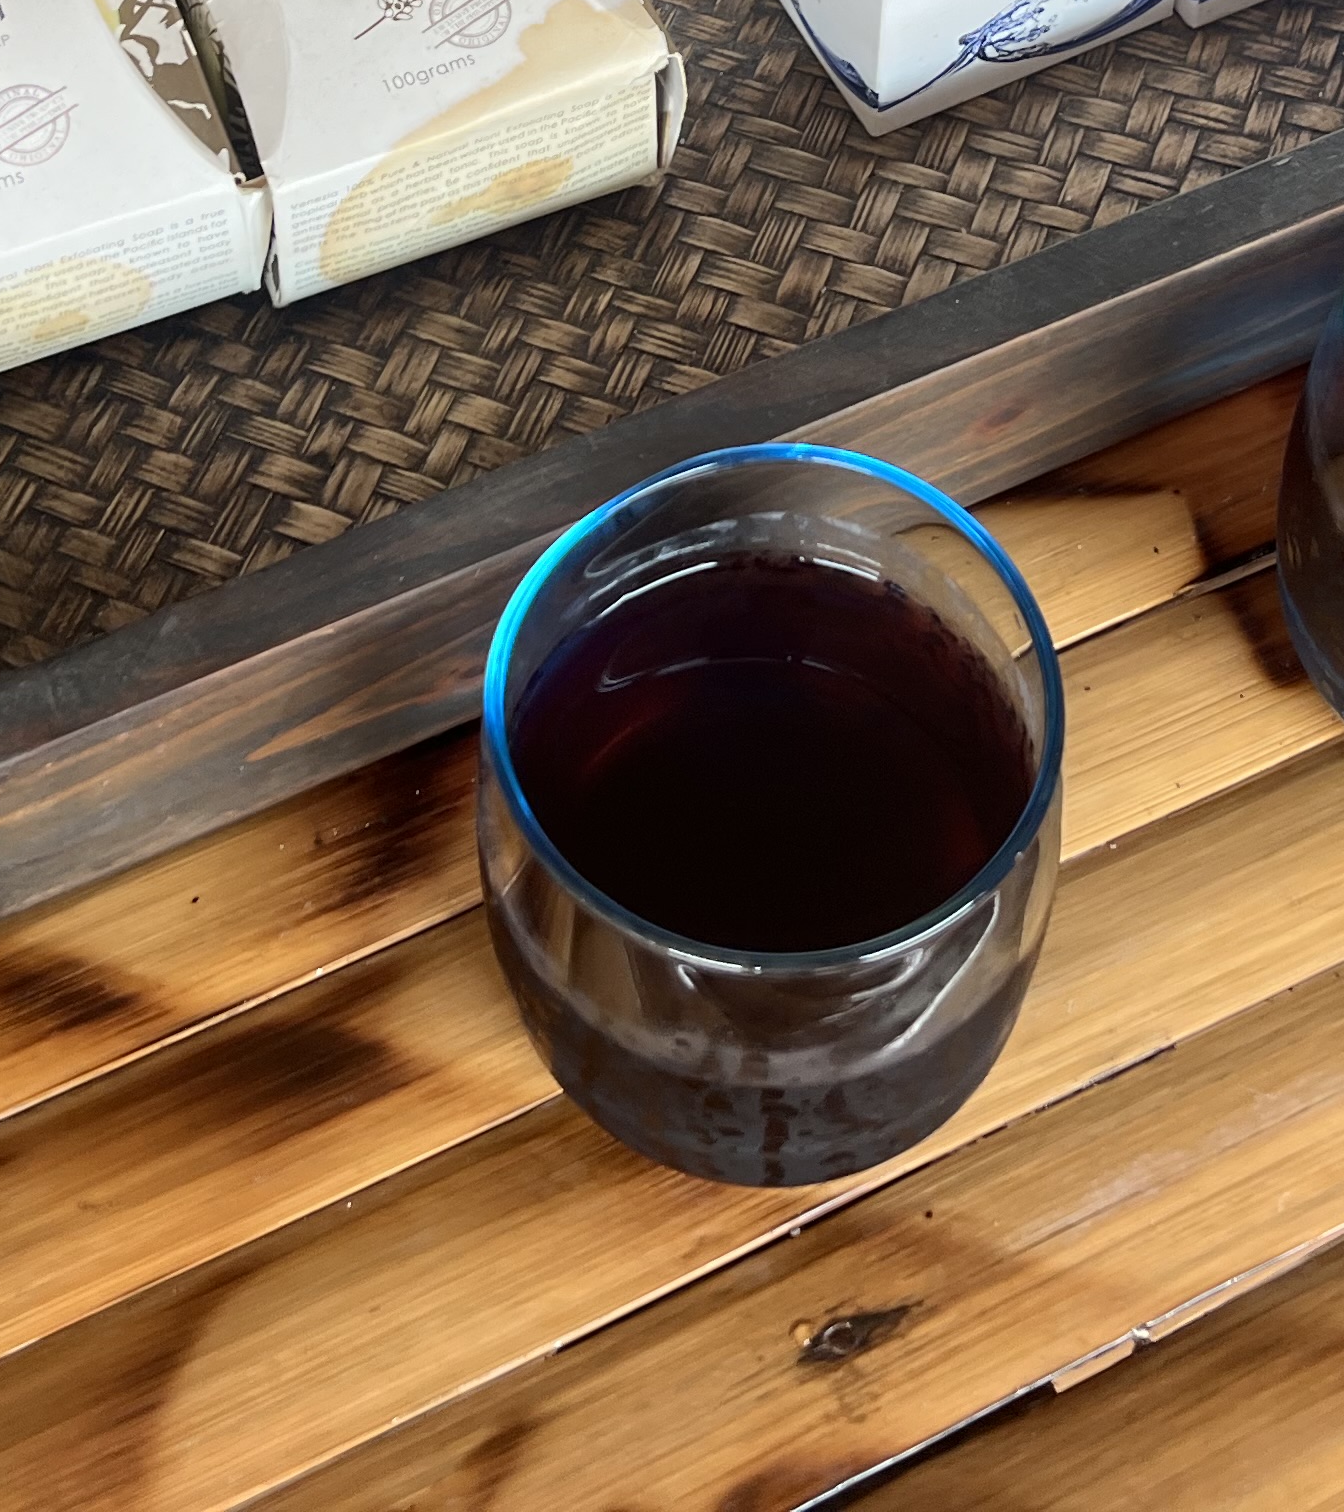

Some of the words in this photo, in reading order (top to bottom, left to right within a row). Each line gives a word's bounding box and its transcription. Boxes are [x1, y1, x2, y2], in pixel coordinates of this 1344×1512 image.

[382, 51, 476, 94] 100grams
[293, 190, 338, 208] Venezia
[383, 168, 405, 179] Pure
[428, 144, 468, 161] Natural
[476, 132, 499, 145] Noni
[507, 110, 564, 134] Exfoliating
[572, 98, 599, 112] Soap
[294, 200, 337, 218] tropical
[372, 179, 403, 193] which
[429, 157, 458, 171] been
[462, 143, 495, 159] widely
[500, 133, 524, 146] used
[528, 127, 536, 136] in
[542, 122, 557, 132] the
[563, 109, 597, 125] Pacific
[406, 173, 442, 190] herbal
[491, 148, 508, 159] This
[517, 137, 543, 151] soap
[566, 118, 600, 134] known
[468, 155, 519, 178] confident
[529, 145, 550, 158] that
[25, 262, 53, 274] Noni
[61, 239, 125, 263] Exfoliating
[133, 227, 164, 241] Soap
[202, 209, 224, 220] true
[102, 251, 120, 262] the
[124, 238, 164, 254] Pacific
[213, 218, 227, 228] for
[130, 248, 169, 263] known
[199, 230, 229, 243] have
[201, 239, 230, 252] body
